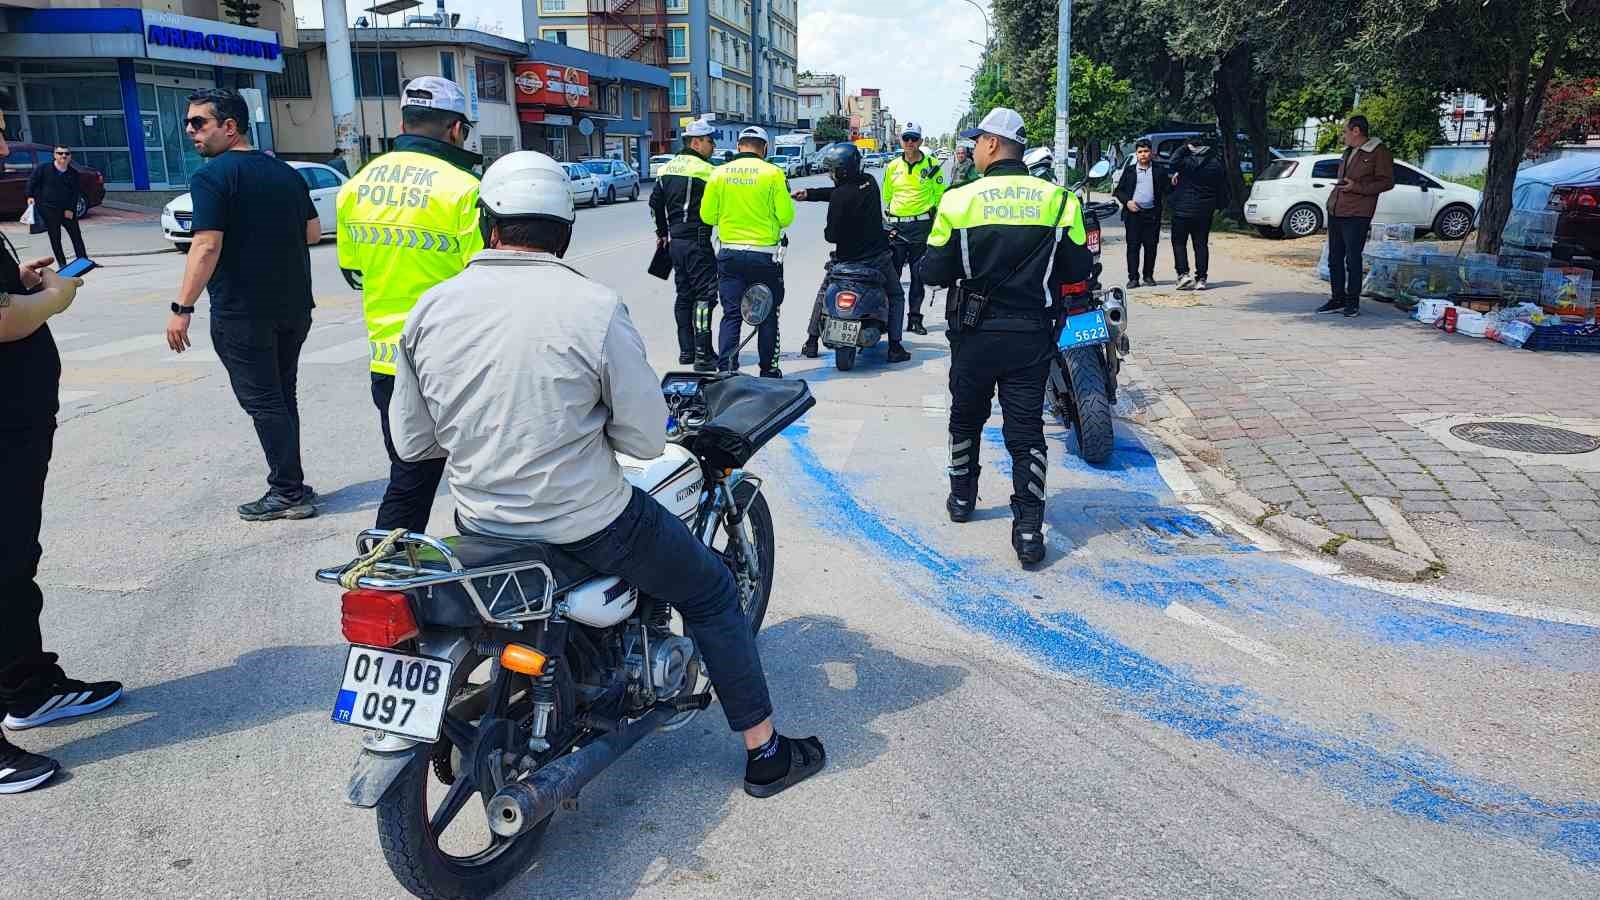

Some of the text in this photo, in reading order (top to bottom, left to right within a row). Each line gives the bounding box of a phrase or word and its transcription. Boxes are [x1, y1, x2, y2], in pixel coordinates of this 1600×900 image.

[366, 164, 438, 187] TRAFİK
[357, 184, 432, 209] POLİSİ
[979, 186, 1043, 202] TRAFİK
[983, 205, 1040, 219] POLİSİ
[1075, 327, 1106, 342] 5622
[354, 654, 442, 695] 01 AOB
[338, 709, 350, 720] TR
[362, 692, 416, 727] 097
